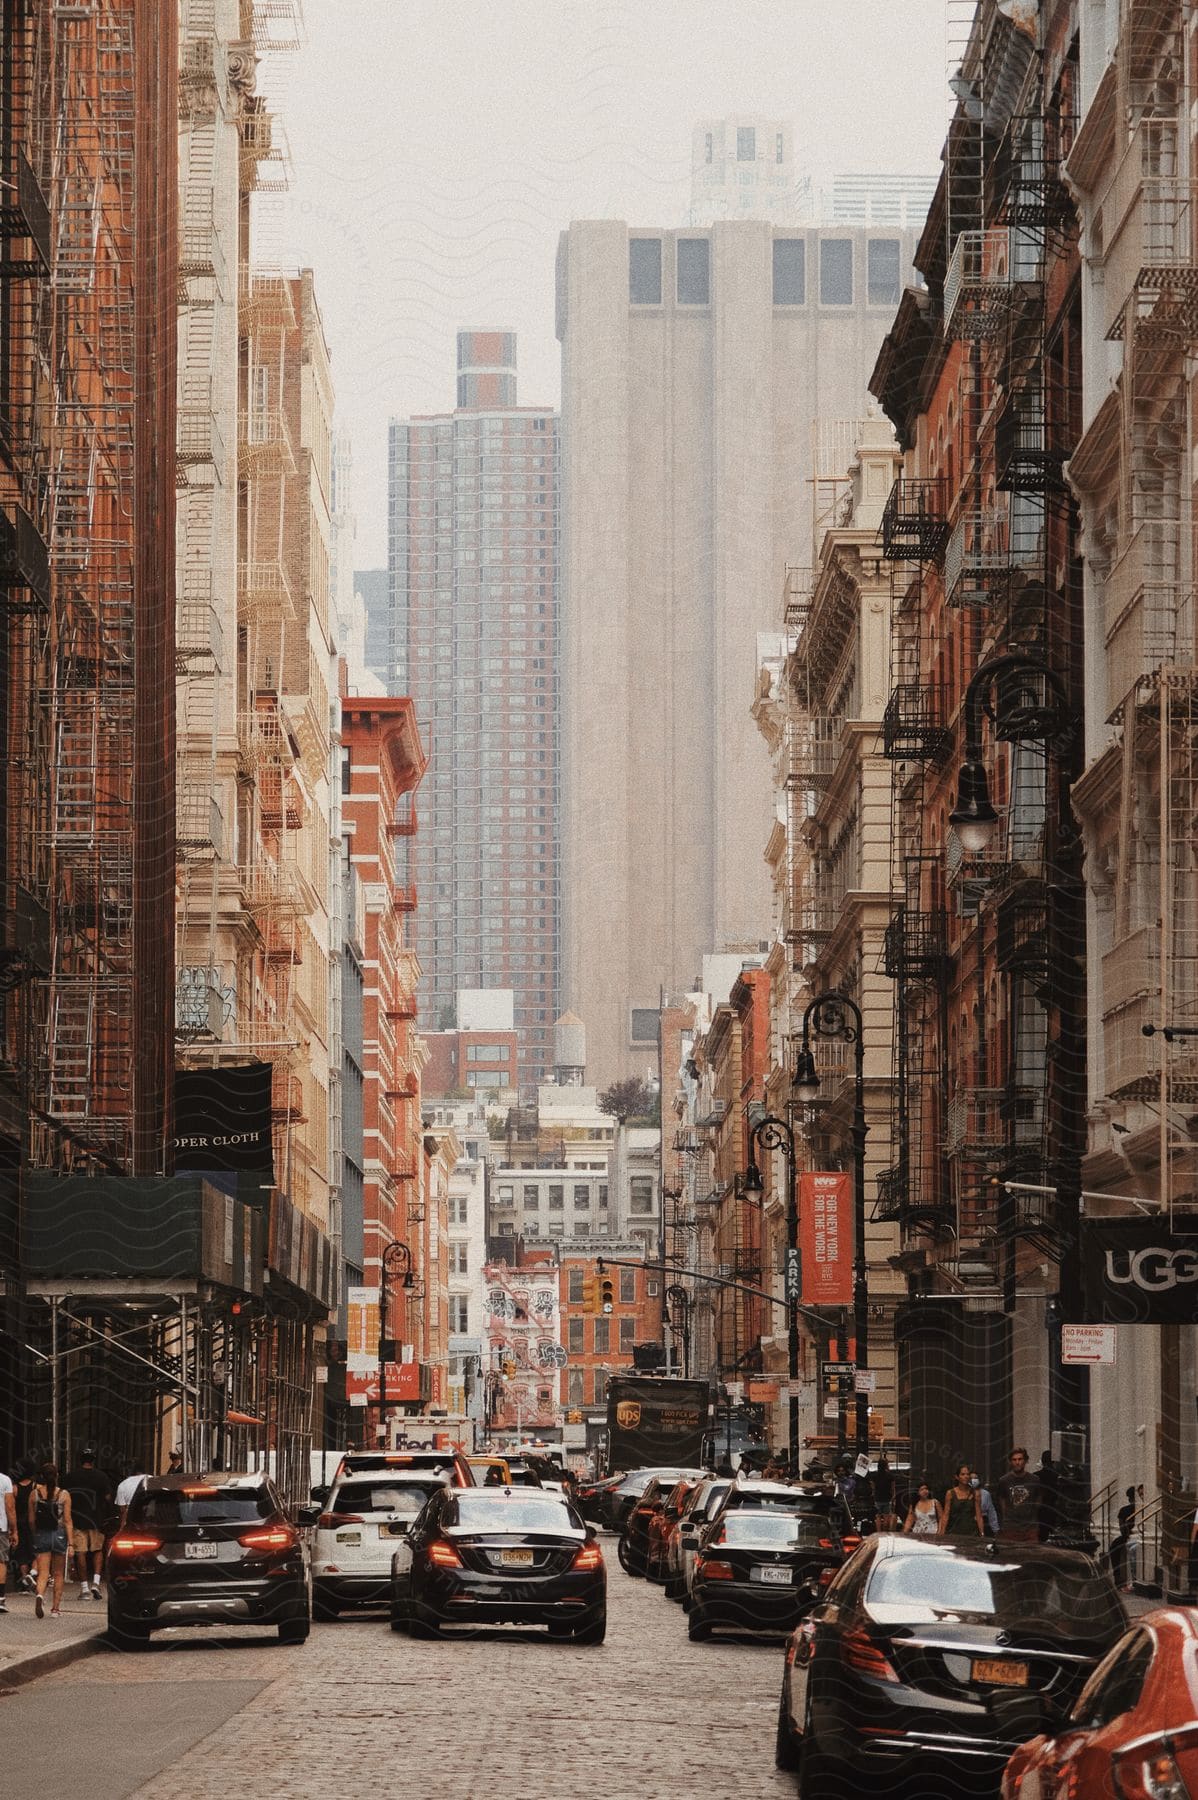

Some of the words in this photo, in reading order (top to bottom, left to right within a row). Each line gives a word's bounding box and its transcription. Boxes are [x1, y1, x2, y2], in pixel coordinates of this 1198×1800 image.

[212, 1132, 260, 1146] CLOTH
[814, 1177, 838, 1186] NYC
[814, 1194, 825, 1212] FOR
[826, 1194, 838, 1213] FOR
[815, 1212, 825, 1230] THE
[826, 1214, 838, 1238] NEW
[815, 1231, 826, 1263] WORLD
[826, 1238, 838, 1262] YORK
[788, 1249, 799, 1286] PARK
[1104, 1247, 1198, 1292] UGG
[1076, 1329, 1104, 1337] PARKING
[619, 1410, 640, 1425] ups
[396, 1433, 468, 1456] FedEx
